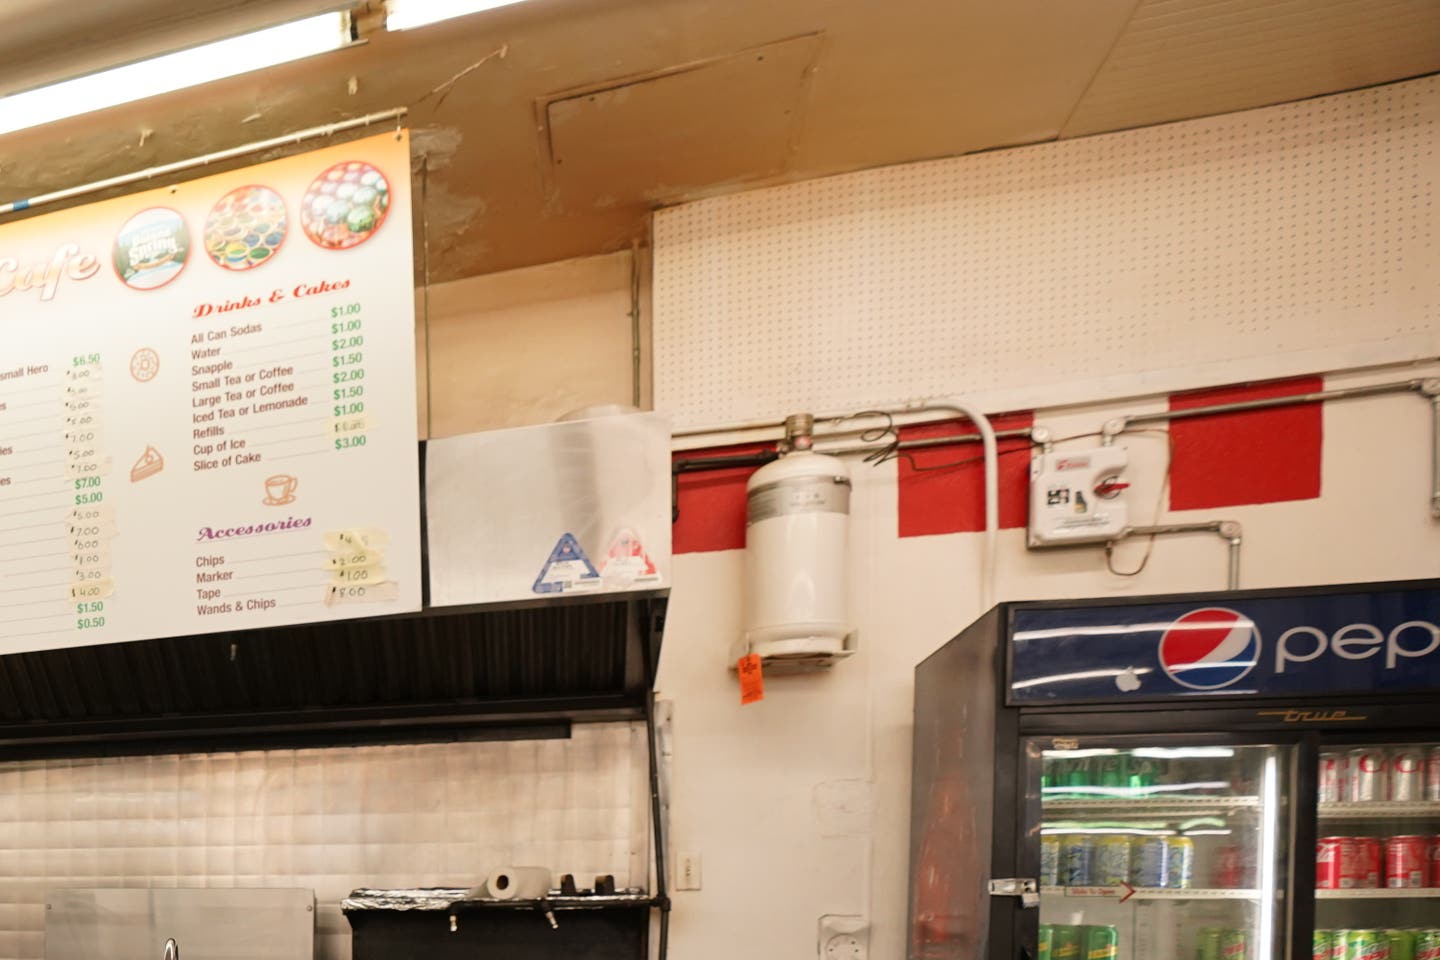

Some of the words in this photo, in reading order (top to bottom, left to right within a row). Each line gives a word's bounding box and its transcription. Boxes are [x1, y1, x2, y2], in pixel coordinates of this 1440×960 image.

[192, 298, 261, 318] Drinks
[269, 290, 284, 303] &
[293, 280, 351, 298] Cakes
[331, 304, 360, 317] $1.00
[332, 320, 361, 333] $1.00
[190, 333, 204, 344] All
[207, 330, 227, 340] Can
[230, 324, 262, 336] Sodas
[332, 336, 363, 350] $2.00
[191, 347, 220, 359] Water
[333, 353, 362, 366] $1.50
[191, 360, 232, 375] Snapple
[191, 377, 220, 391] Small
[224, 375, 241, 385] Tea
[244, 373, 255, 382] or
[258, 366, 293, 379] Coffee
[333, 369, 364, 383] $2.00
[192, 395, 221, 407] Large
[224, 391, 242, 401] Tea
[245, 389, 256, 398] or
[259, 382, 294, 395] Coffee
[334, 386, 363, 400] $1.50
[192, 410, 214, 423] Iced
[217, 408, 235, 418] Tea
[238, 406, 249, 415] or
[252, 396, 308, 413] Lemonade
[334, 402, 364, 416] $1.00
[192, 425, 224, 438] Refills
[192, 444, 213, 455] Cup
[216, 440, 226, 451] of
[230, 439, 246, 449] Ice
[336, 435, 366, 450] $3.00
[193, 460, 218, 470] Slice
[221, 455, 231, 466] of
[234, 452, 261, 464] Cake
[75, 478, 100, 489] $7.00
[75, 493, 102, 504] $5.00
[197, 517, 312, 541] Accessories
[195, 555, 224, 567] Chips
[196, 571, 233, 582] Marker
[196, 588, 220, 600] Tape
[77, 602, 104, 614] $1.50
[196, 602, 232, 615] Wands
[234, 601, 243, 611] &
[246, 598, 276, 610] Chips
[77, 617, 105, 629] $0.50
